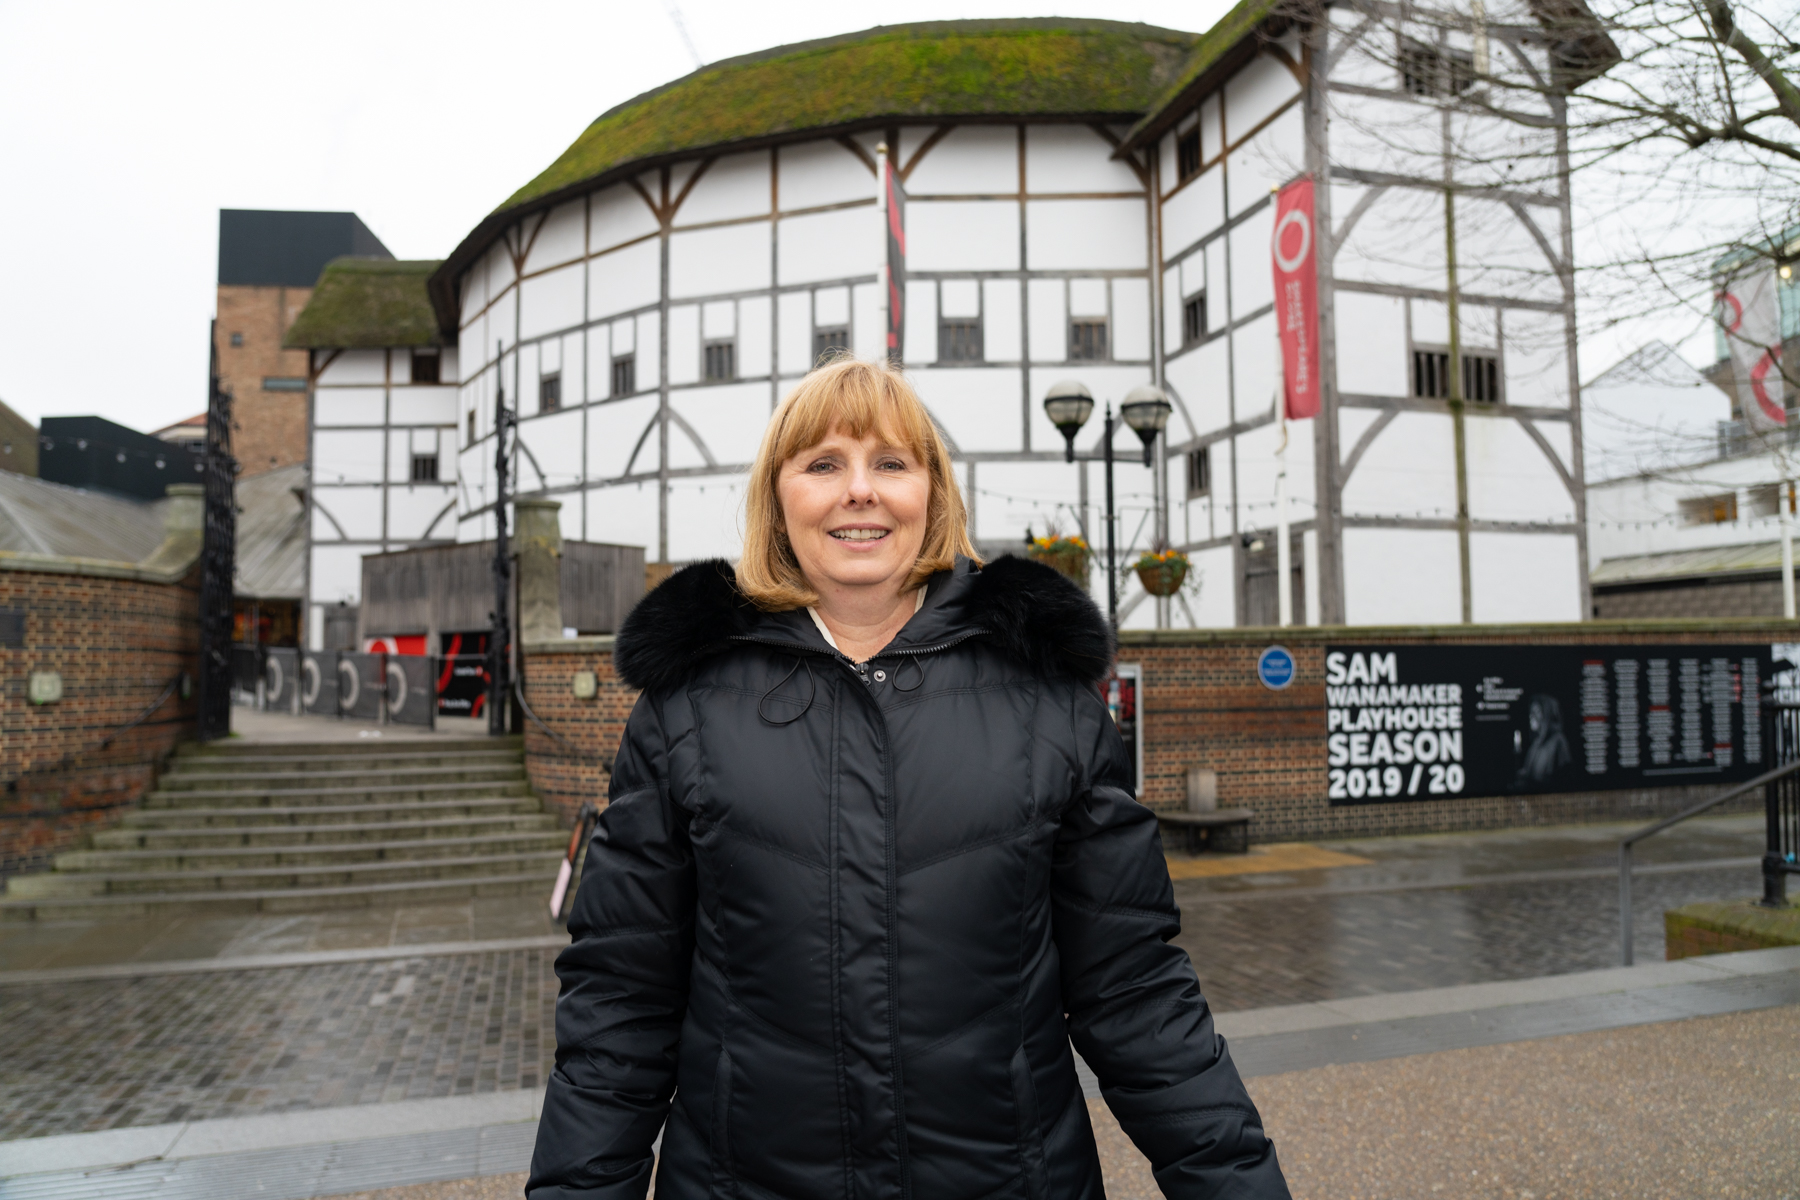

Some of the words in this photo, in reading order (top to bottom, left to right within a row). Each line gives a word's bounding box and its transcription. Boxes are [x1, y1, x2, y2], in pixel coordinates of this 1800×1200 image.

[1326, 652, 1398, 685] SAM
[1326, 684, 1463, 707] WANAMAKER
[1328, 706, 1463, 732] PLAYHOUSE
[1328, 730, 1463, 767] SEASON
[1328, 766, 1403, 799] 2019
[1428, 763, 1465, 794] 20
